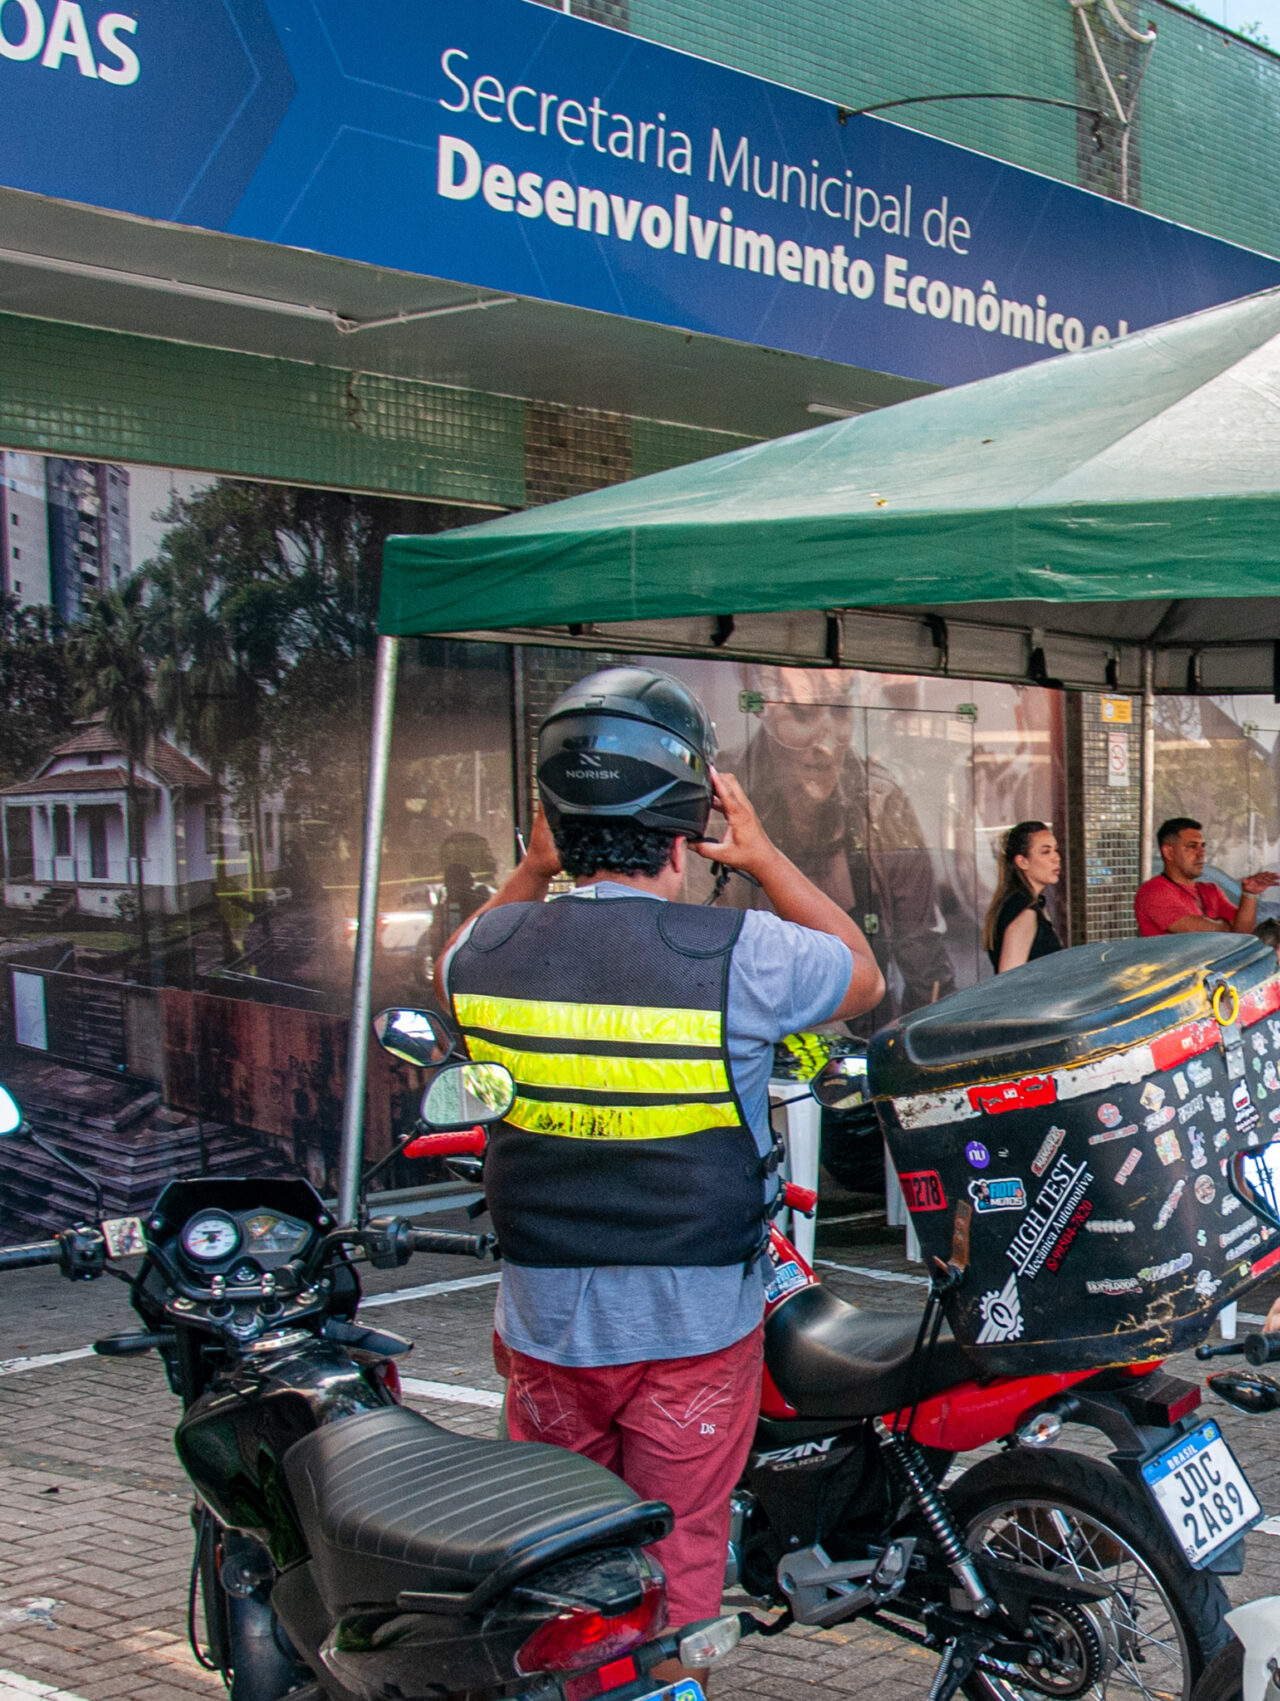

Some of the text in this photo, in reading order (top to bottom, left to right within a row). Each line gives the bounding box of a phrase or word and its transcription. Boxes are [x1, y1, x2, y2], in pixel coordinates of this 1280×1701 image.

[438, 47, 971, 256] Secretaria Municipal de
[436, 133, 875, 301] Desenvolvimento
[883, 252, 1086, 353] Econômico
[565, 769, 621, 781] NORISK
[989, 1197, 1024, 1206] MOTOS
[1005, 1205, 1047, 1268] HIGH
[1036, 1153, 1078, 1212] TEST
[1023, 1171, 1095, 1280] Mecânica Automotiva
[700, 1423, 716, 1435] DS
[754, 1434, 842, 1469] FAN
[1166, 1443, 1199, 1470] BRASIL
[1174, 1451, 1222, 1508] JDC
[1183, 1481, 1244, 1550] 2A89
